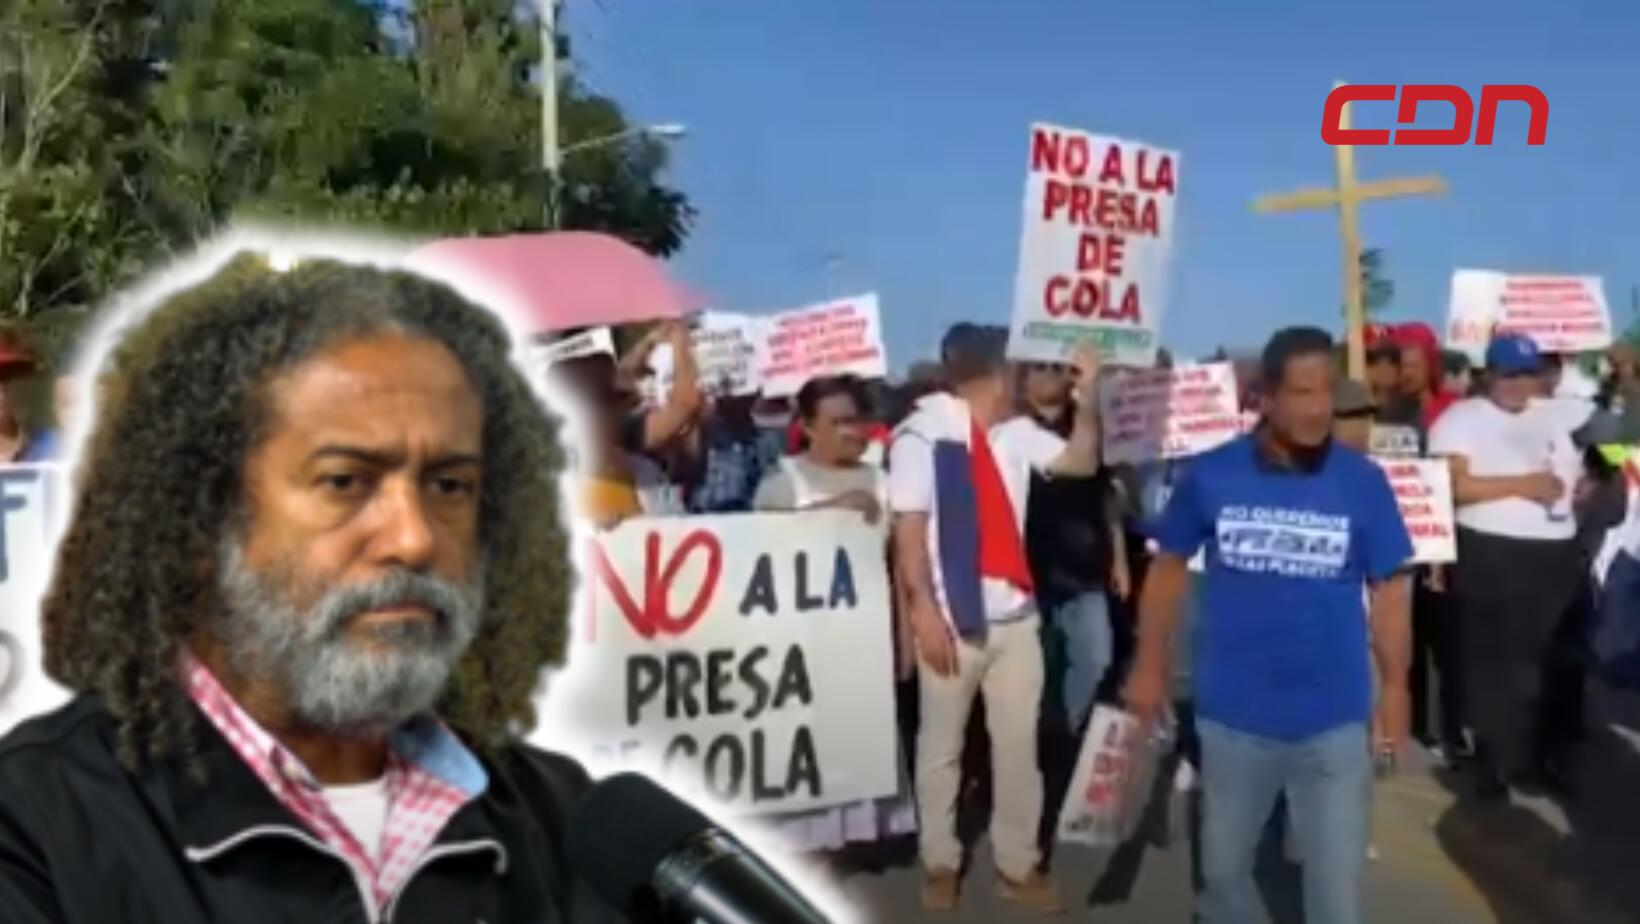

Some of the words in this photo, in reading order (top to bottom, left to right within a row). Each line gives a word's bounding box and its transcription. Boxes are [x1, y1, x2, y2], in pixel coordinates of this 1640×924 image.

[1032, 129, 1089, 177] NO
[1100, 144, 1124, 184] A
[1136, 151, 1174, 194] LA
[1043, 180, 1159, 236] PRESA
[1076, 233, 1125, 275] DE
[1044, 276, 1141, 323] COLA
[584, 527, 723, 643] NO
[739, 553, 778, 616] A
[795, 546, 858, 611] LA
[627, 643, 813, 727] PRESA
[664, 725, 822, 803] COLA
